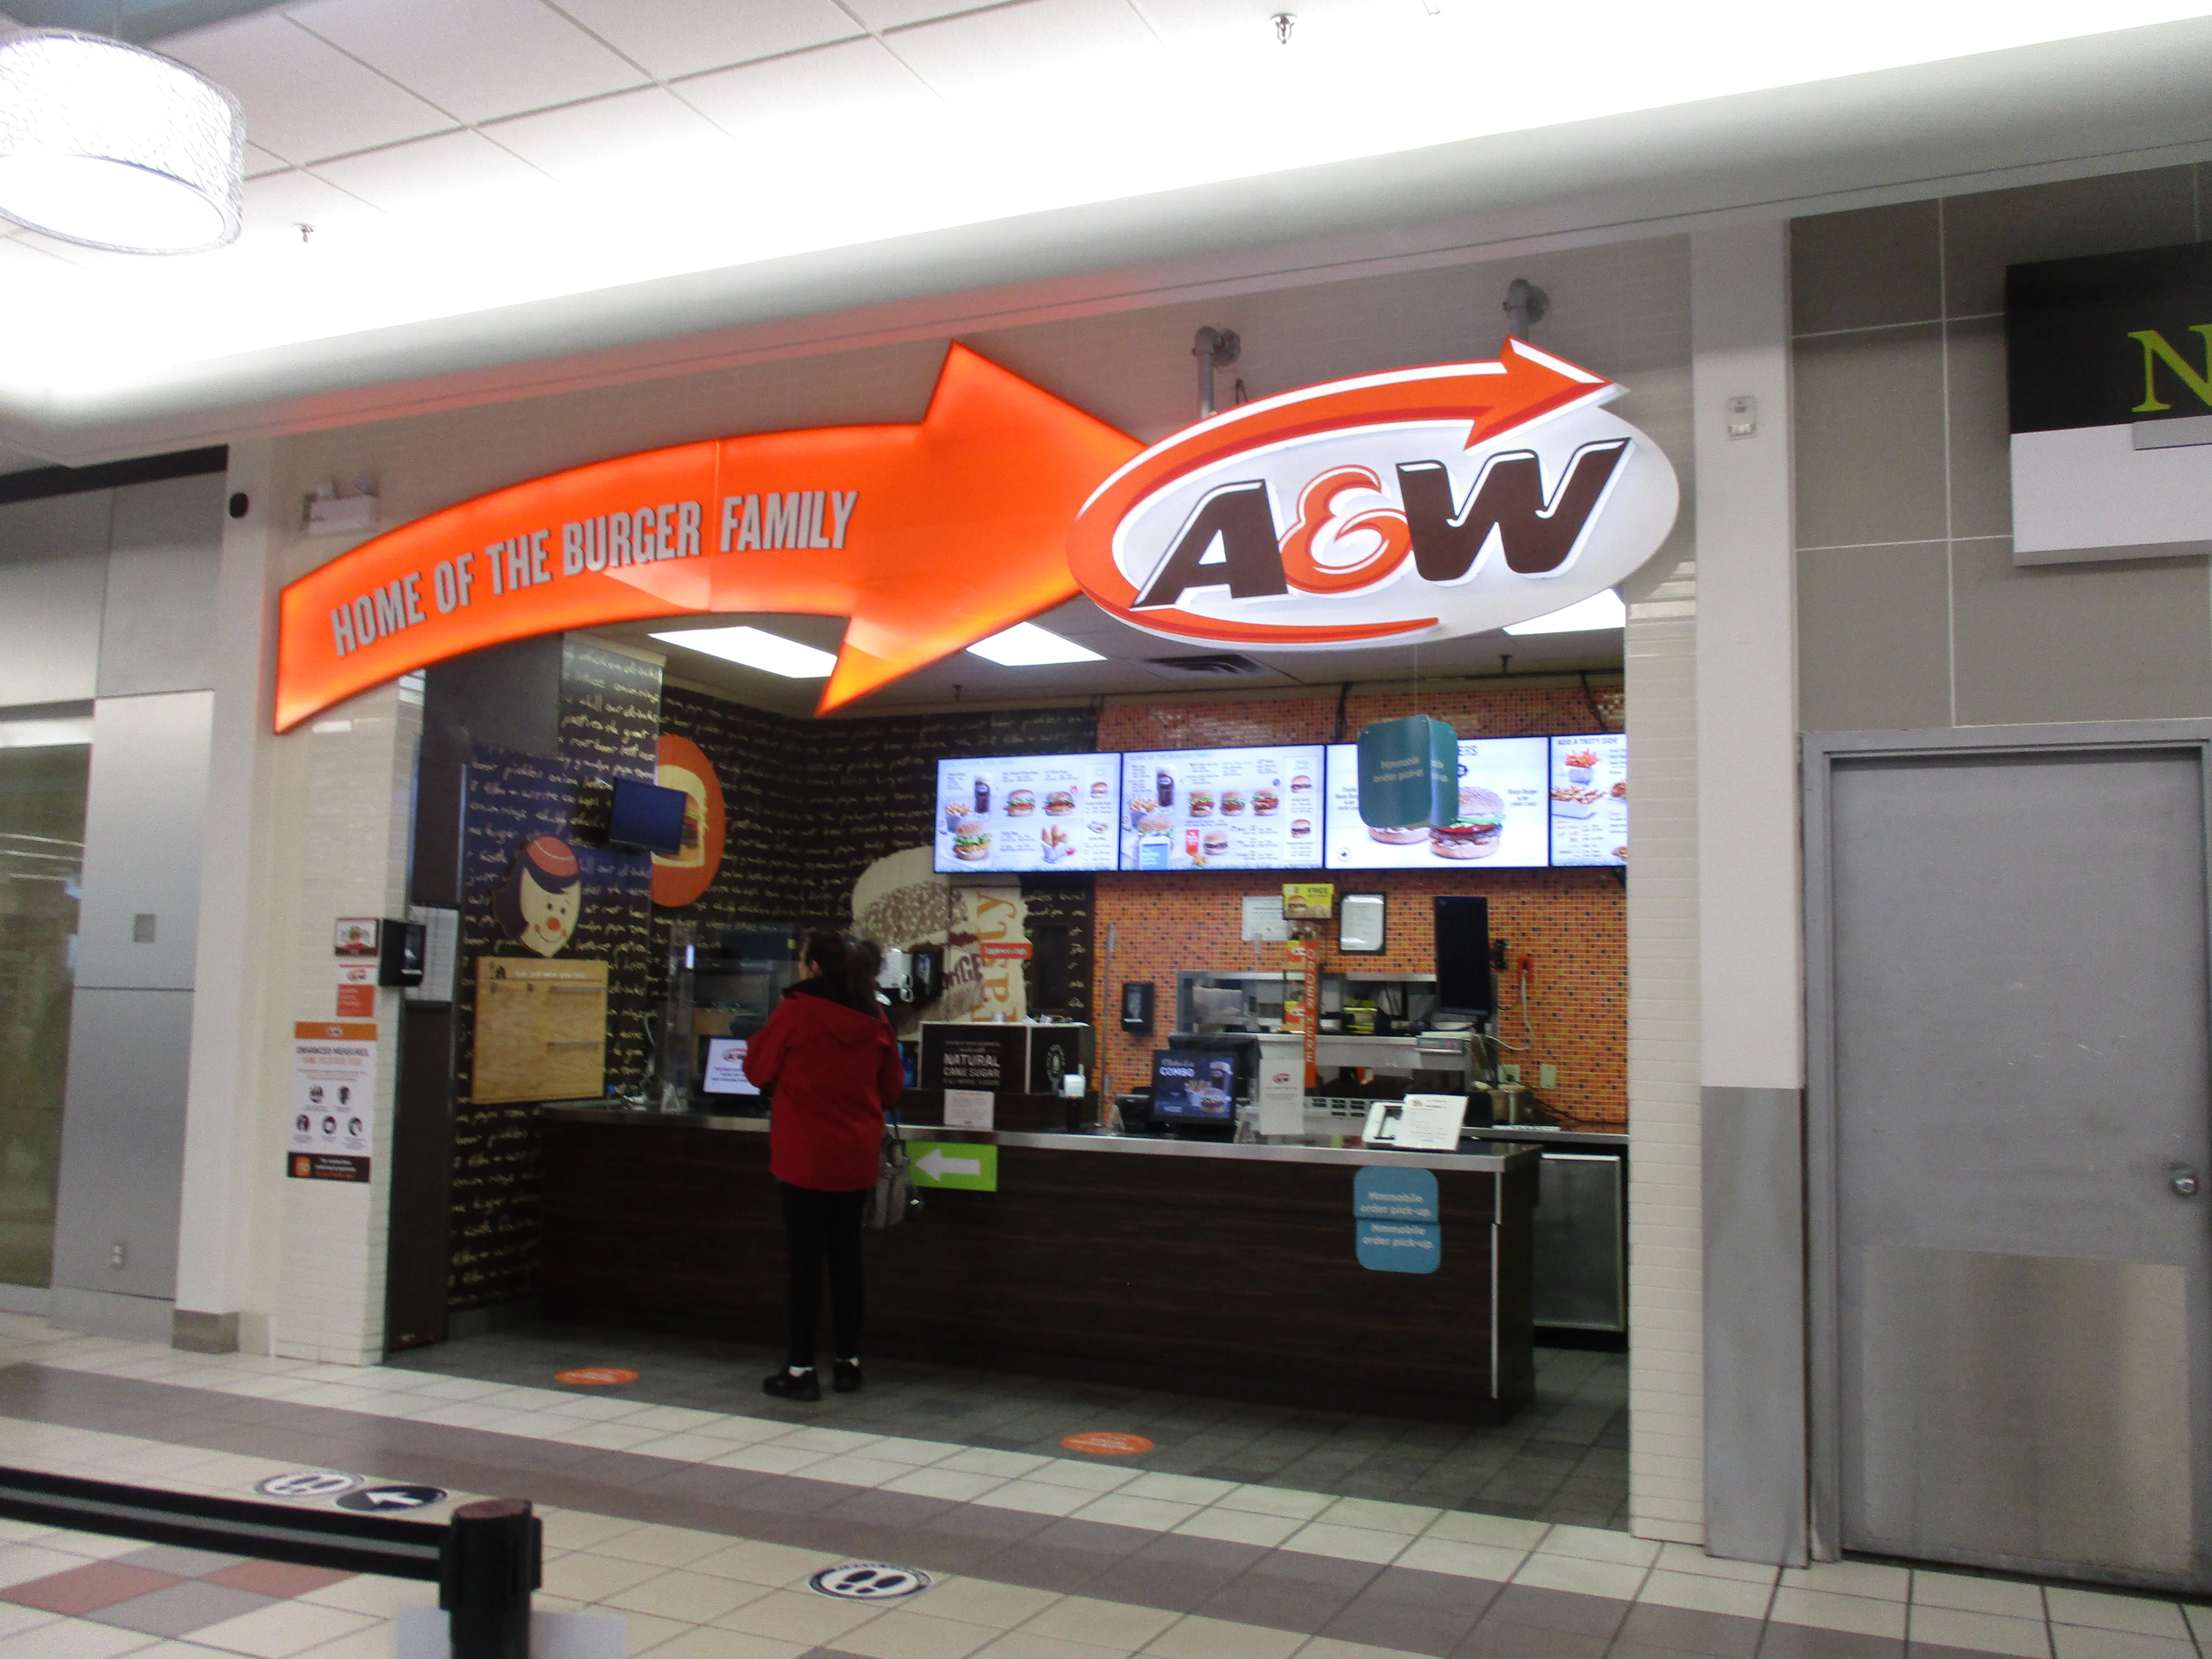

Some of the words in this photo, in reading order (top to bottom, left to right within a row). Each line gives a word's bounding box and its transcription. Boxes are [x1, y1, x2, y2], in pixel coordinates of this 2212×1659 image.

[1130, 436, 1632, 611] A&W
[331, 571, 425, 657] HOME
[434, 553, 474, 614] OF
[485, 529, 553, 595] THE
[562, 500, 702, 575] BURGER
[720, 490, 859, 553] FAMILY
[943, 1053, 1001, 1068] NATURAL
[943, 1066, 968, 1077] CANE
[969, 1068, 1000, 1078] SUGAR
[1159, 1066, 1195, 1077] COMBO
[1359, 1204, 1389, 1214] order
[1361, 1237, 1390, 1246] order
